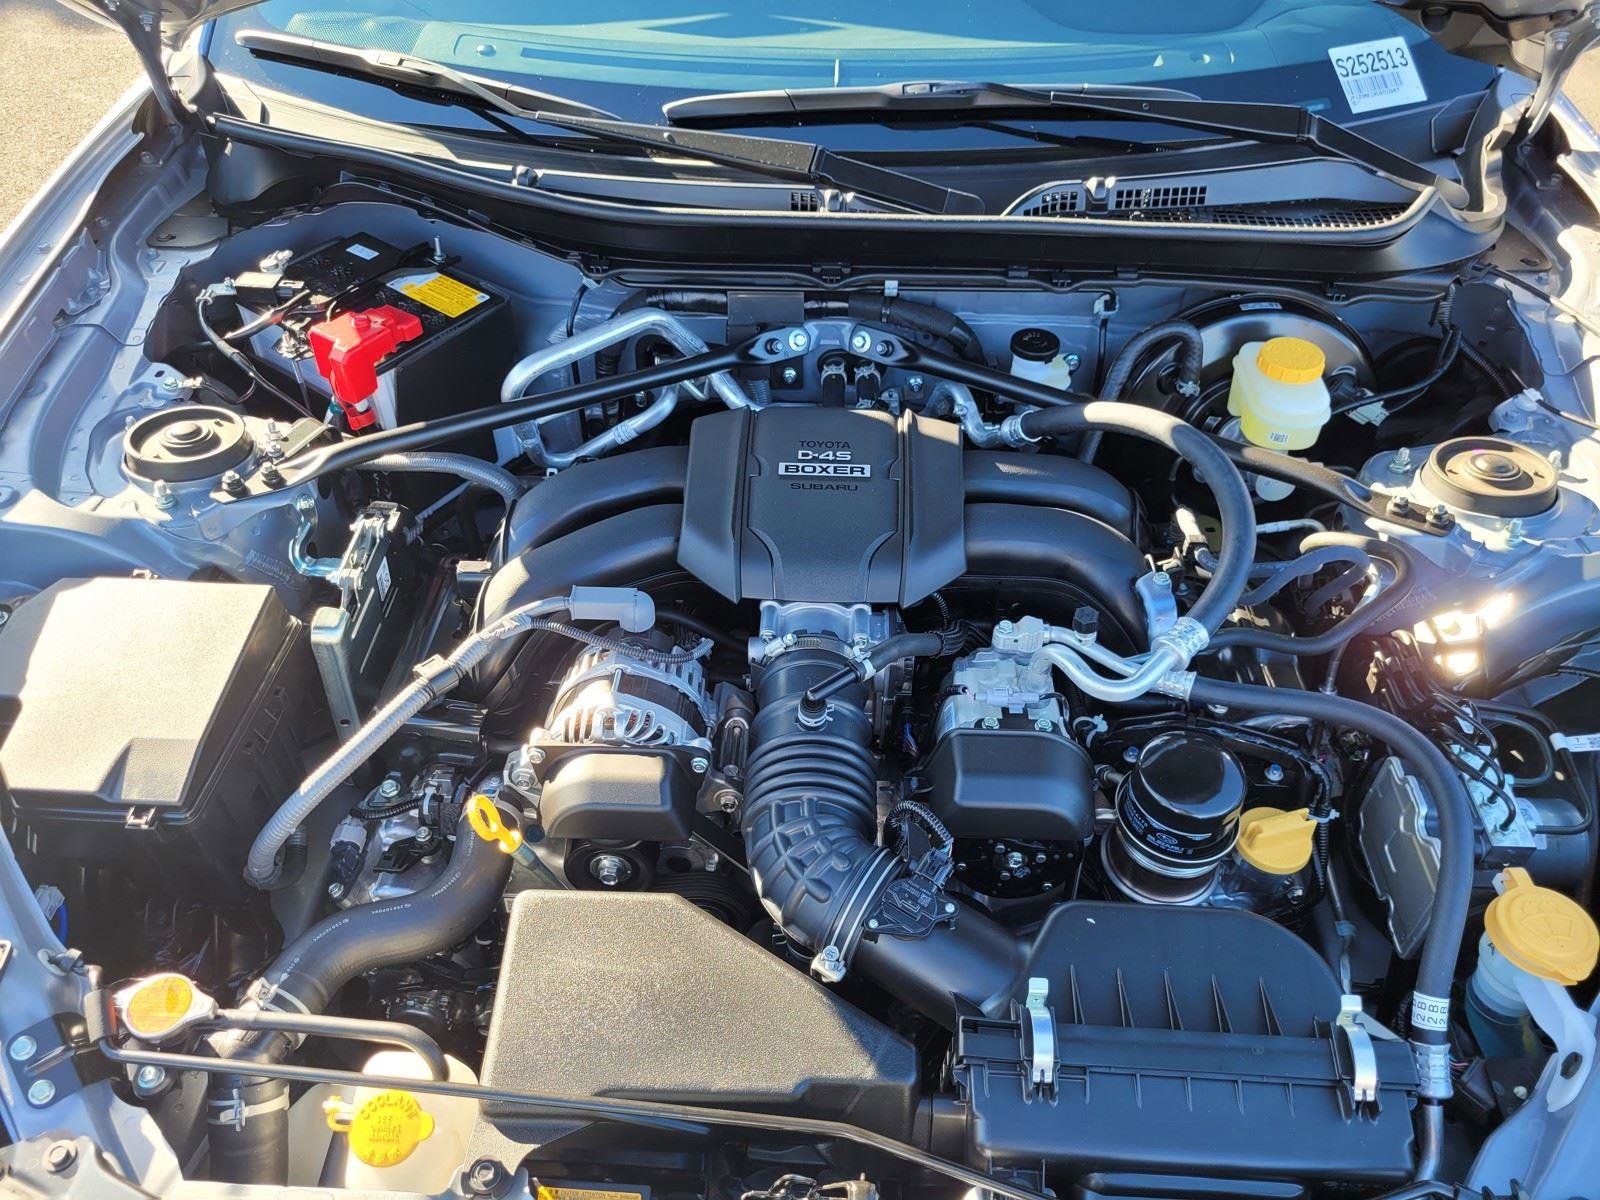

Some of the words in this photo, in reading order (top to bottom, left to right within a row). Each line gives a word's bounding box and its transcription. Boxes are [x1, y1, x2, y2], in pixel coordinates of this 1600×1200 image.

[1335, 48, 1409, 77] S252513
[799, 440, 851, 449] TOYOTA
[798, 450, 851, 460] D-4S
[784, 464, 866, 475] BOXER
[790, 483, 858, 491] SUBARU
[360, 1094, 420, 1120] COOLANT
